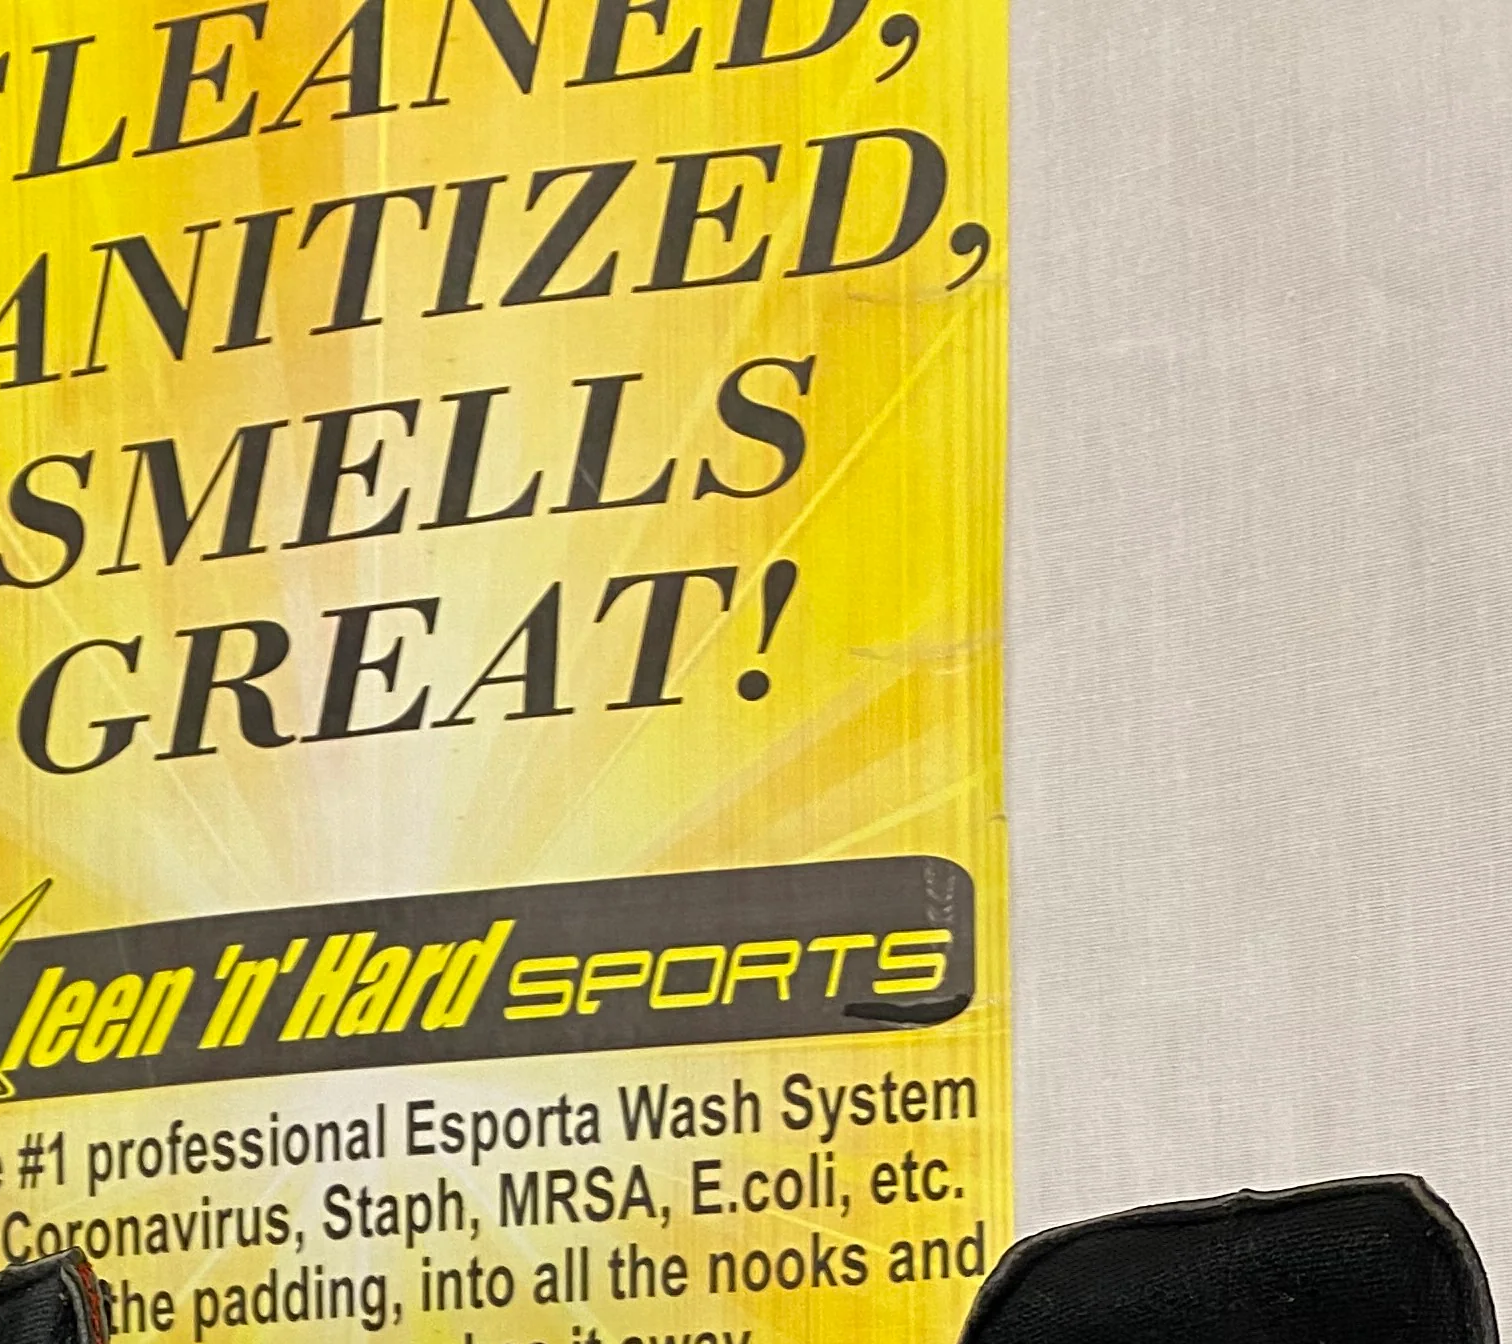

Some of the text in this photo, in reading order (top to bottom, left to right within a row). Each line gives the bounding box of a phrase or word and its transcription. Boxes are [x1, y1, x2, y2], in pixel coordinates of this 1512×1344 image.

[19, 560, 798, 775] GREAT!
[278, 920, 516, 1042] Hard
[503, 929, 952, 1021] SPORTS
[18, 1132, 65, 1189] #1
[89, 1103, 386, 1198] professional
[406, 1095, 602, 1168] Esporta
[617, 1078, 761, 1141] Wash
[781, 1071, 978, 1144] System
[2, 1195, 305, 1265] Coronavirus,
[322, 1177, 480, 1249] Staph,
[499, 1164, 671, 1229] MRSA,
[692, 1151, 851, 1218] E.coli,
[870, 1150, 964, 1206] etc.
[194, 1264, 403, 1343] padding,
[421, 1256, 516, 1313] into
[532, 1246, 590, 1306] all
[607, 1242, 689, 1301] the
[708, 1232, 869, 1295] nooks
[888, 1220, 986, 1285] and
